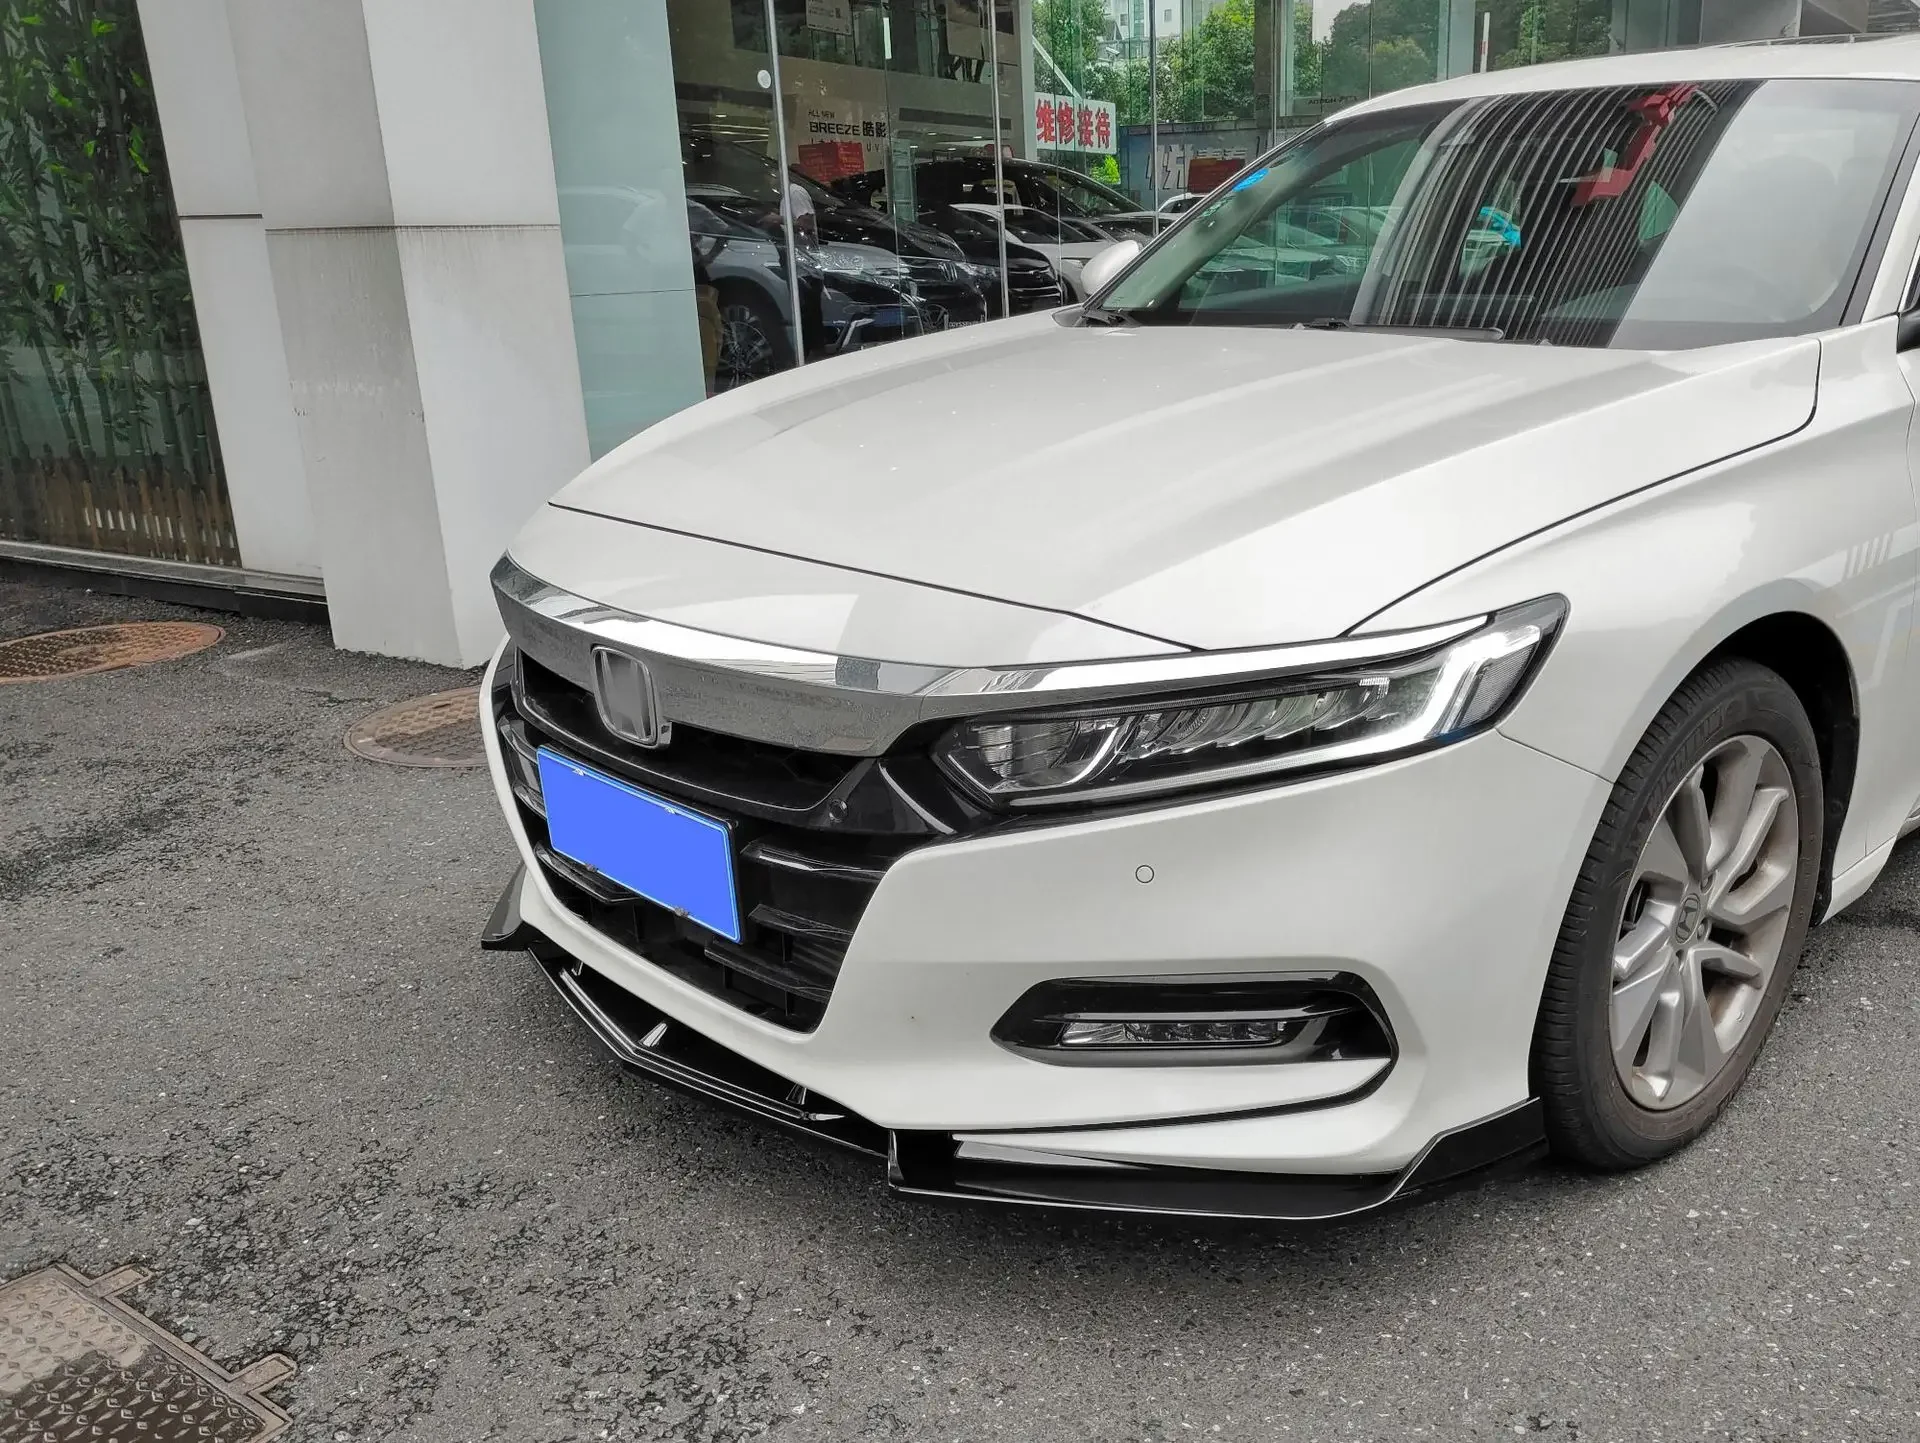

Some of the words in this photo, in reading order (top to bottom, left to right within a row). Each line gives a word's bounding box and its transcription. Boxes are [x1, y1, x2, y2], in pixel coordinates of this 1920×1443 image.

[810, 121, 860, 136] BREEZE
[1036, 98, 1111, 149] 维修接待
